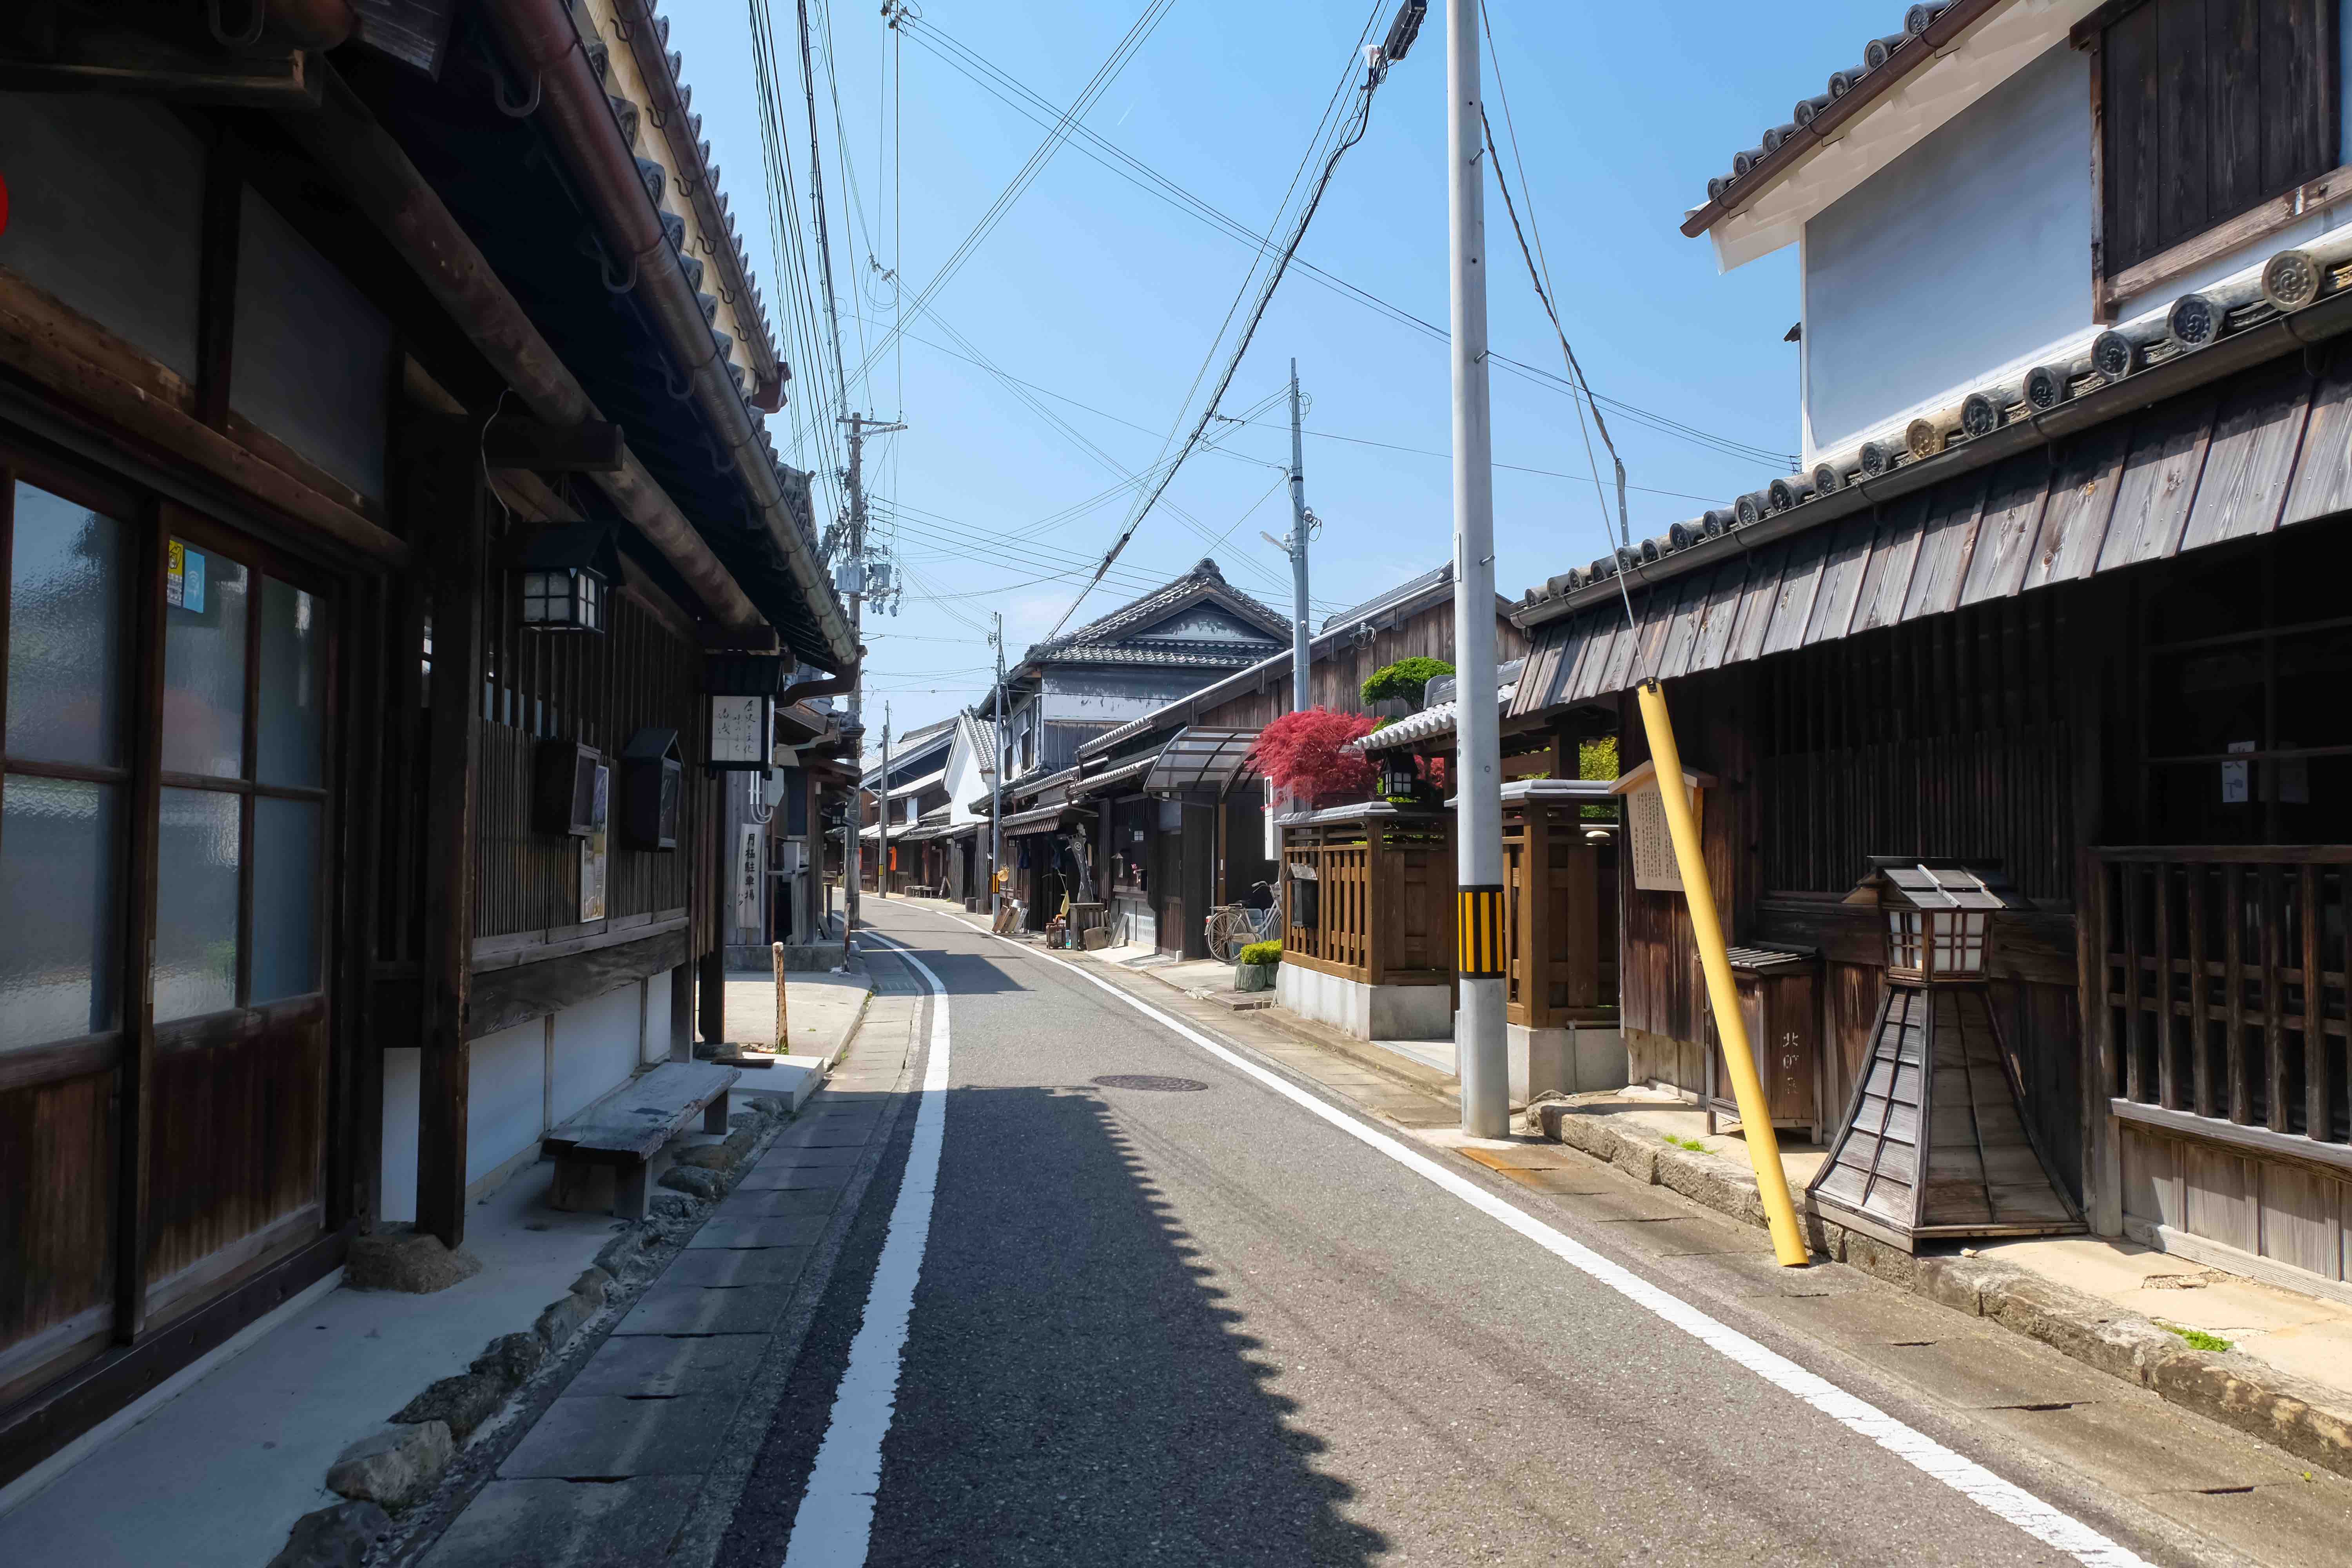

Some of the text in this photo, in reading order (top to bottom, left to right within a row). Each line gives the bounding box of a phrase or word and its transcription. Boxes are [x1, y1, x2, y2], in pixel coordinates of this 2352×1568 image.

[745, 833, 755, 900] 月極駐車場
